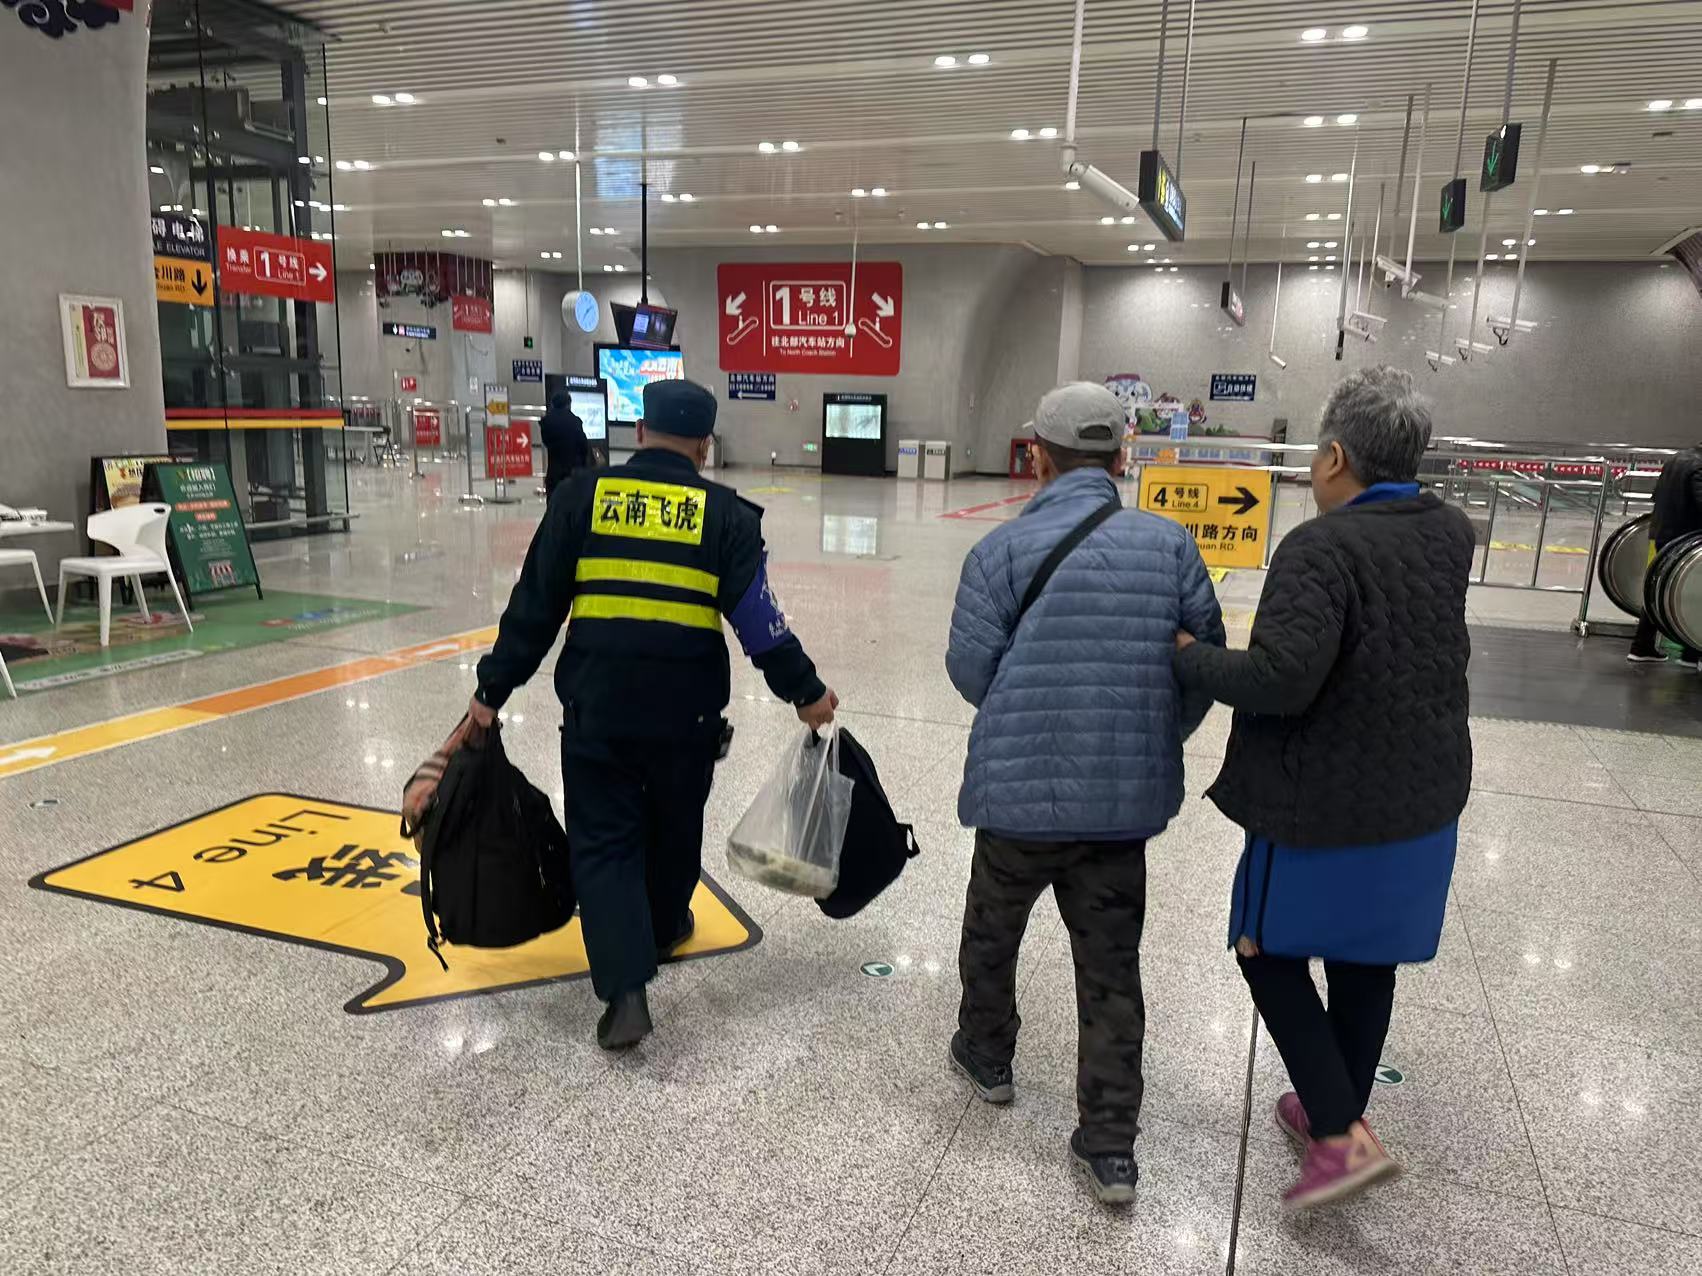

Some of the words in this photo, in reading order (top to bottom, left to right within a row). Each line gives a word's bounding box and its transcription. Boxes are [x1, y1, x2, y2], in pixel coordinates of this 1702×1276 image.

[260, 251, 271, 279] 1
[775, 286, 791, 326] 1
[799, 287, 837, 308] 号线
[798, 310, 828, 326] Line
[832, 310, 839, 326] 1
[771, 336, 845, 349] 往北部汽车站方向
[1153, 487, 1168, 507] 4
[1174, 487, 1199, 499] 号线
[1172, 500, 1191, 508] Line
[599, 488, 698, 531] 云南飞虎
[192, 809, 351, 863] Line
[128, 870, 185, 892] 4
